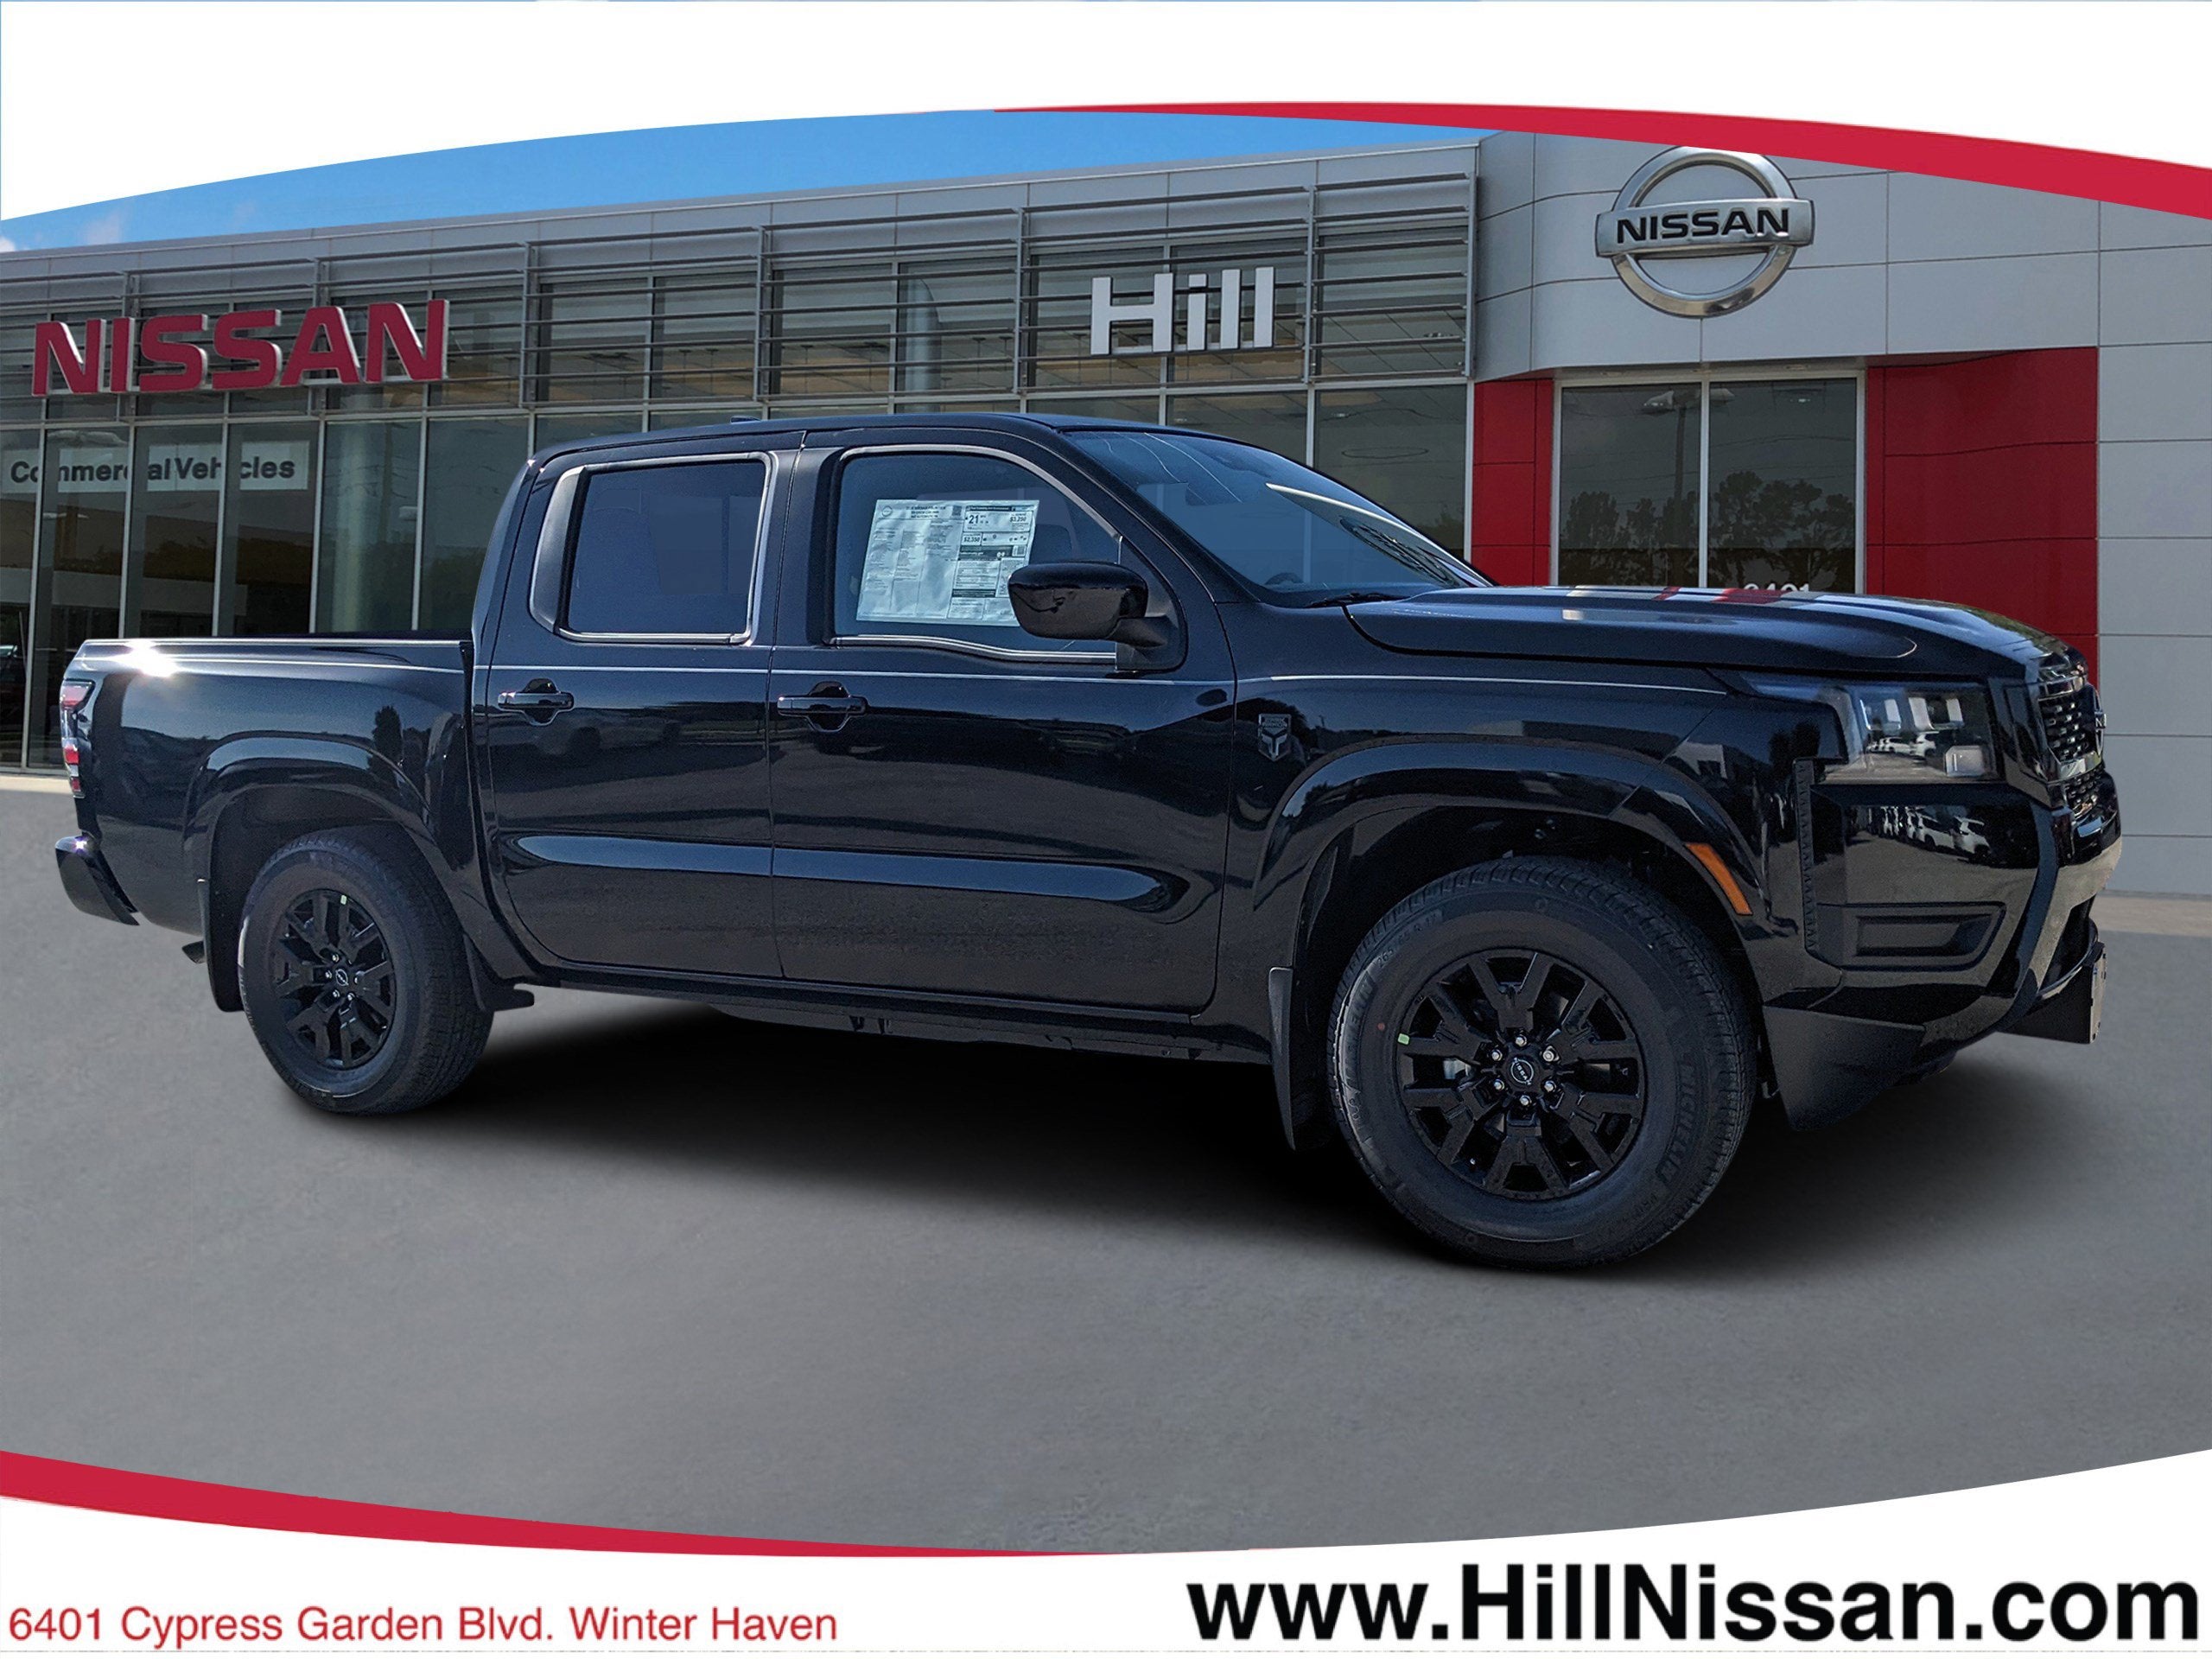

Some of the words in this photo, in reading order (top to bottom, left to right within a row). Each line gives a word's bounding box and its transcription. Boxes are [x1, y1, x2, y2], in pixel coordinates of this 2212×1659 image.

[1617, 207, 1789, 245] NISSAN
[1090, 266, 1275, 355] Hill
[32, 299, 448, 397] NISSAN
[175, 456, 296, 480] Vehcles
